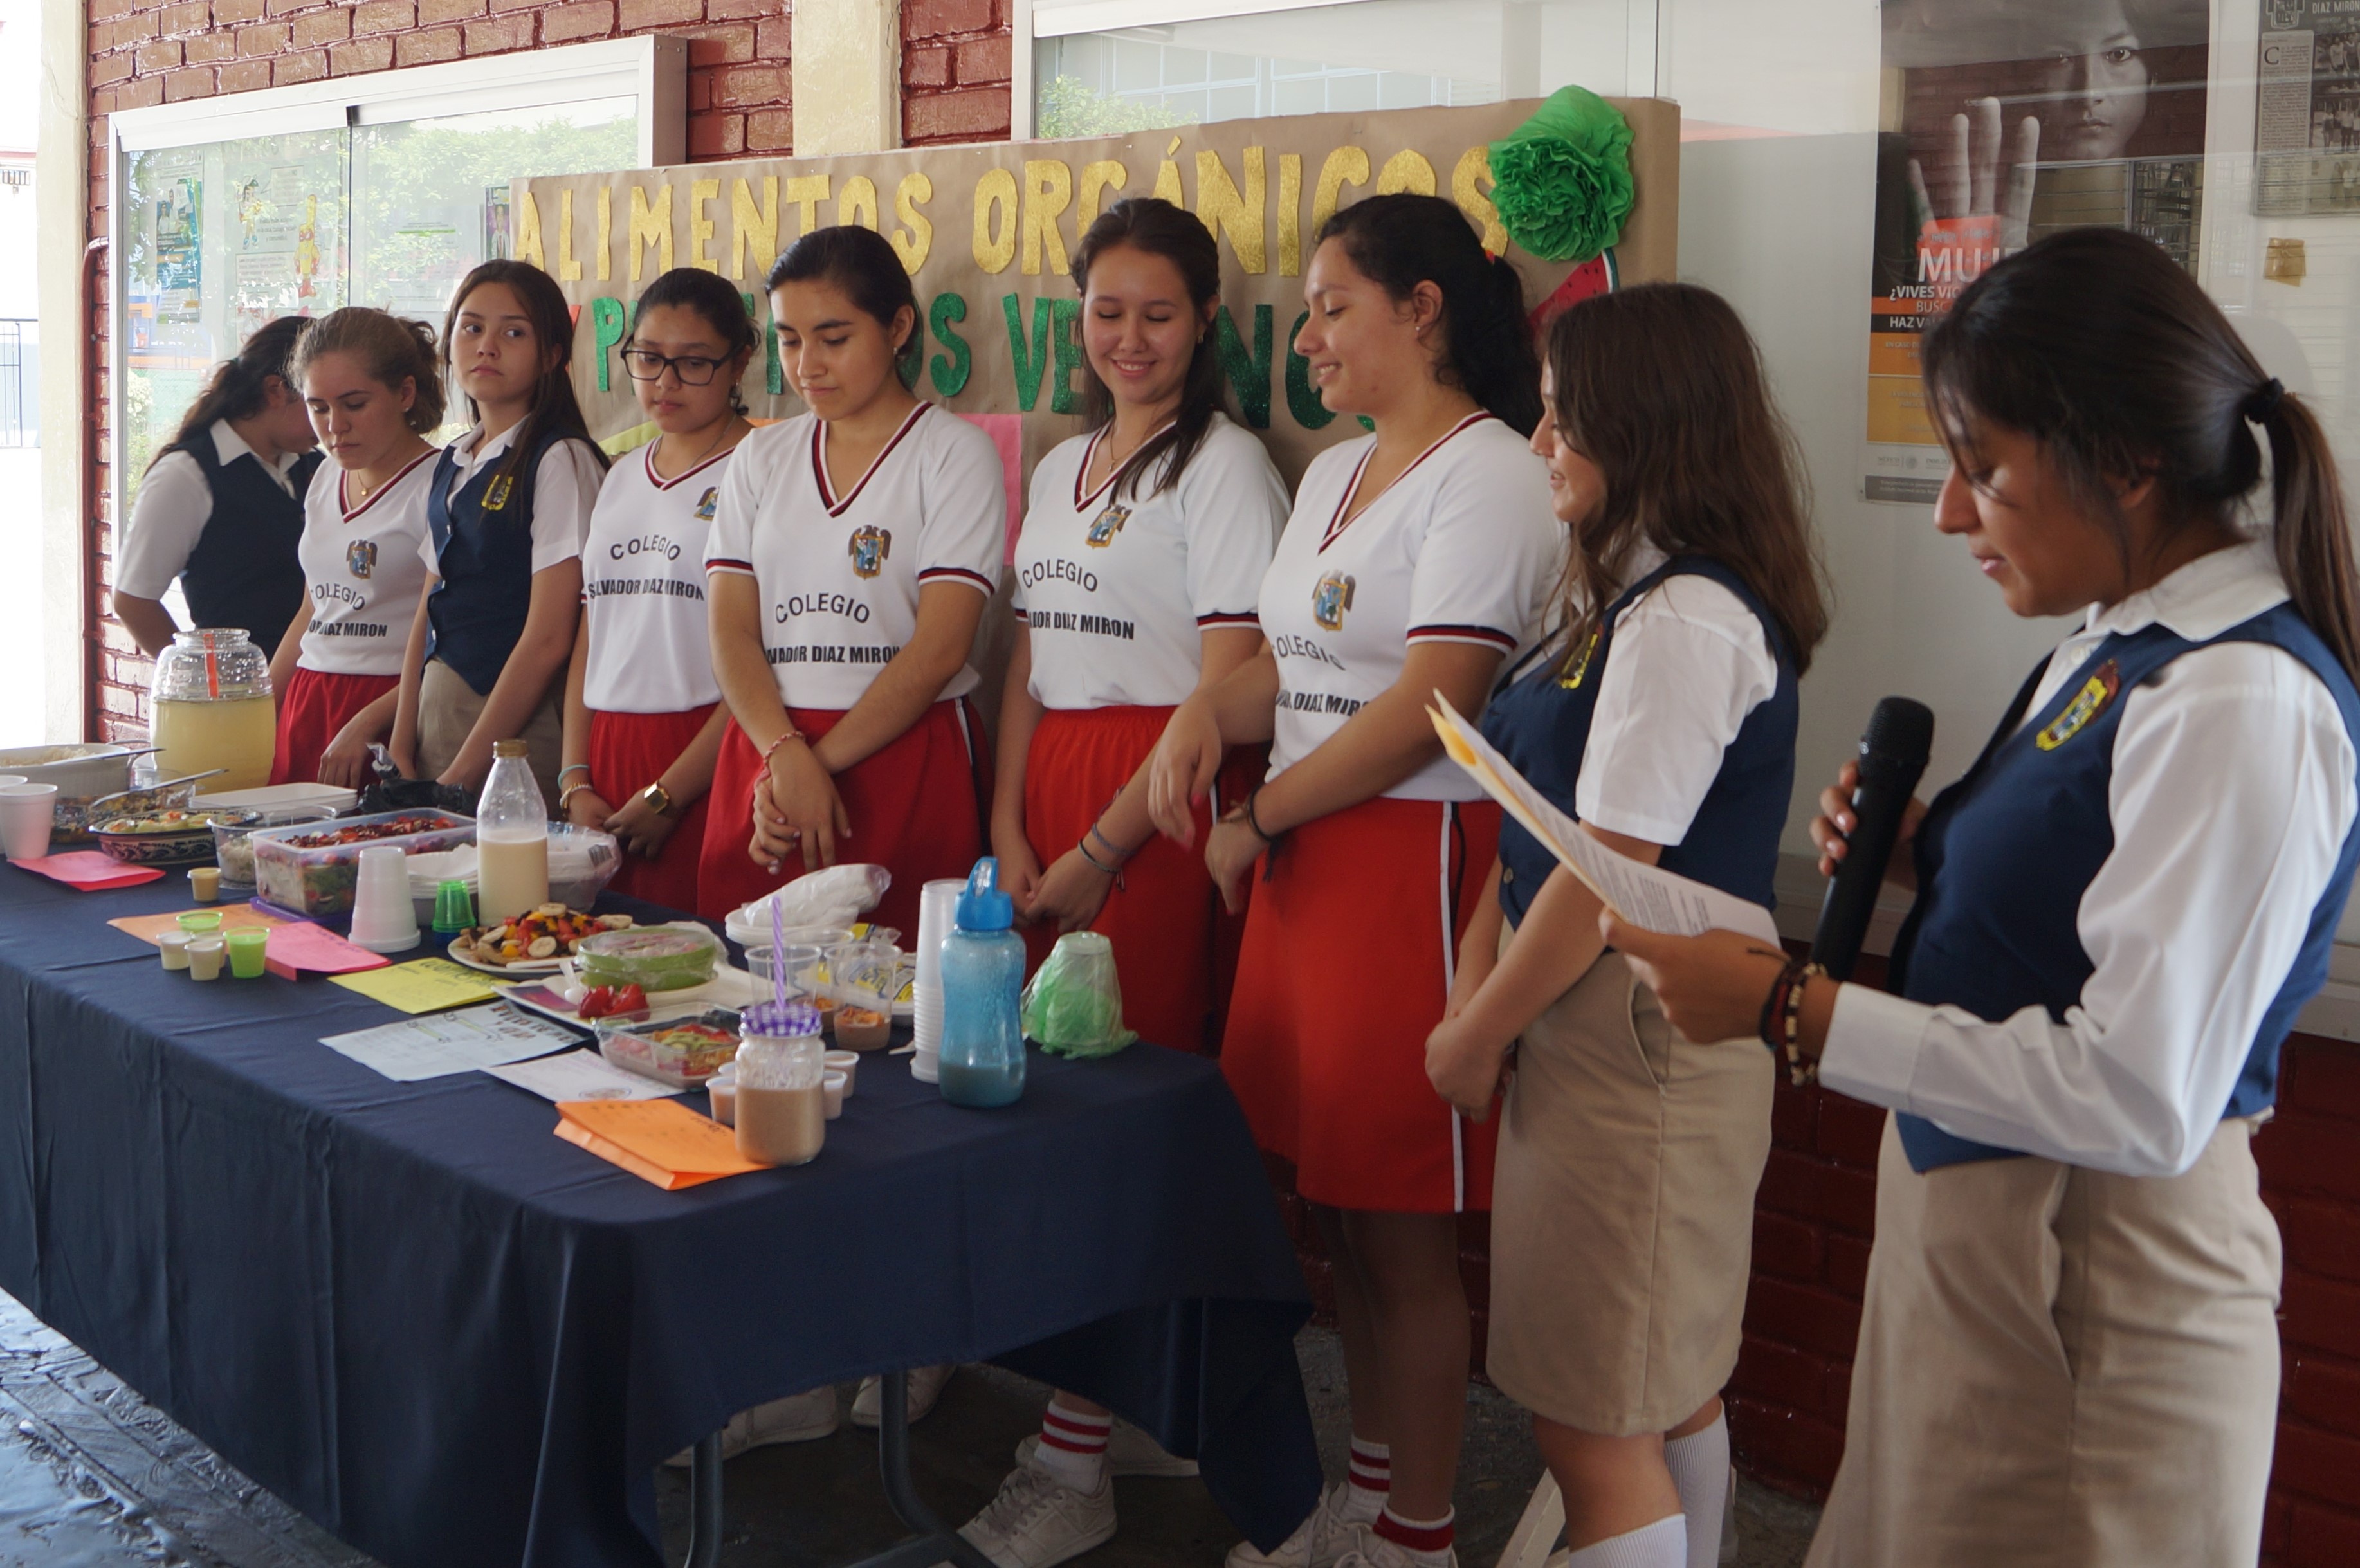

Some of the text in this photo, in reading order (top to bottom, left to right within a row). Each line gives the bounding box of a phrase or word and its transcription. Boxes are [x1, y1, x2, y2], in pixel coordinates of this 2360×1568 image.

[516, 172, 935, 282] ALIMENTOS
[1889, 285, 1935, 302] ¿VIVES
[1889, 316, 1915, 329] HAZ
[609, 534, 681, 561] COLEGIO
[1021, 558, 1098, 592] COLEGIO
[310, 581, 365, 611] OLEGIO
[588, 578, 641, 599] SLVADOR
[774, 592, 871, 624] COLEGIO
[343, 622, 388, 637] MIRON
[1079, 614, 1135, 640] MIRON
[811, 645, 846, 664] DIAZ
[1271, 634, 1346, 671] OLEGI
